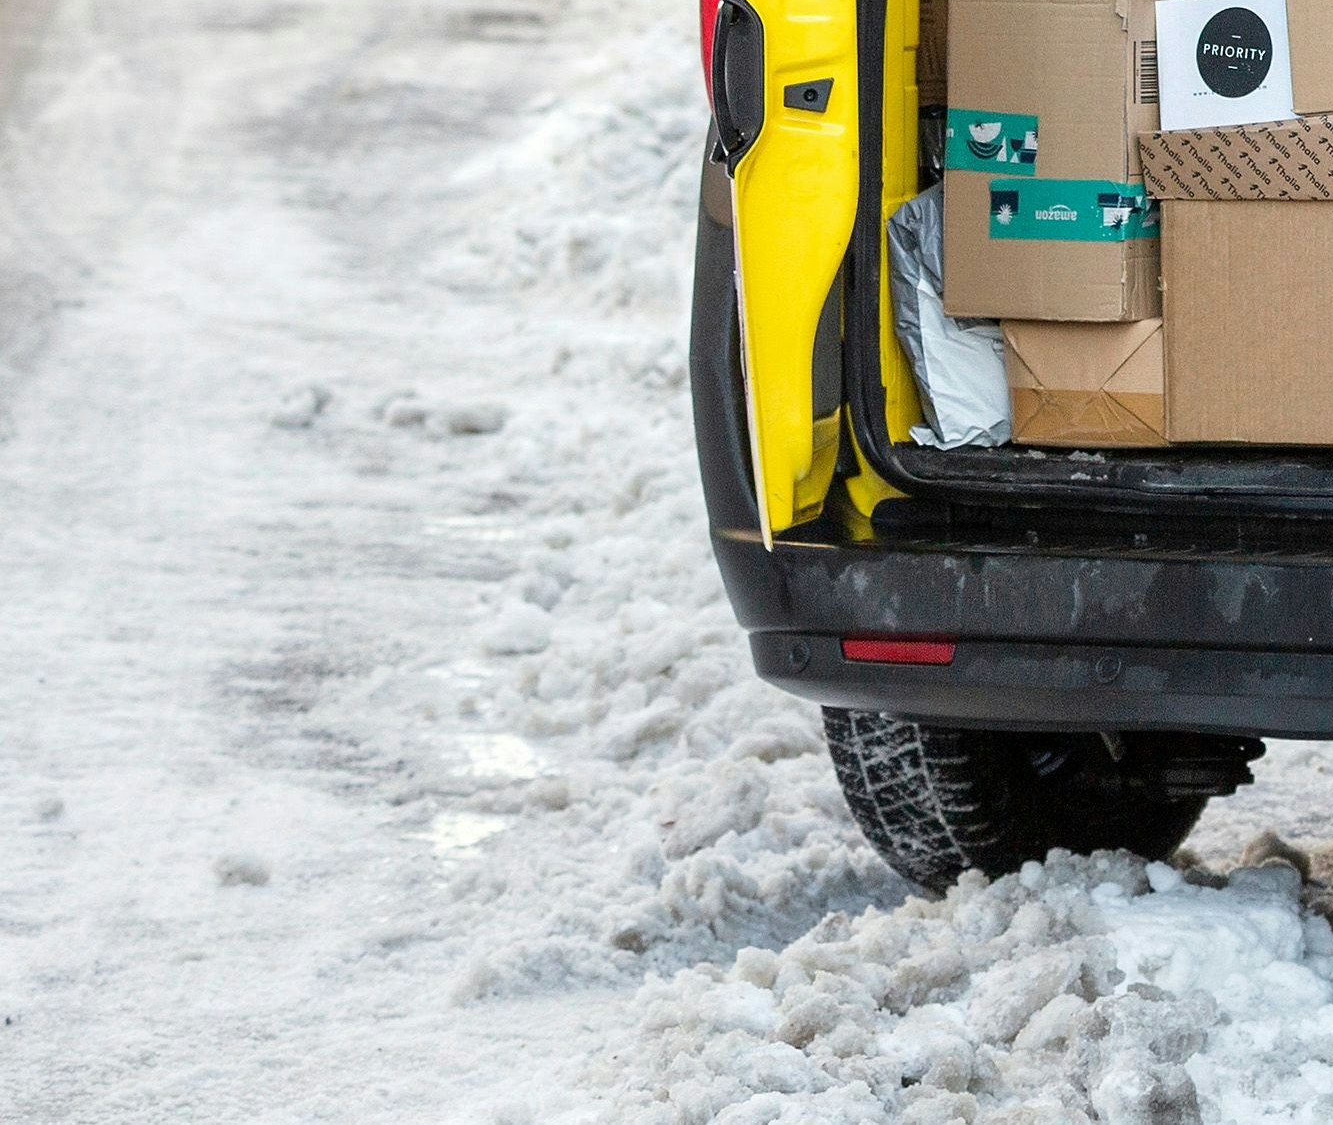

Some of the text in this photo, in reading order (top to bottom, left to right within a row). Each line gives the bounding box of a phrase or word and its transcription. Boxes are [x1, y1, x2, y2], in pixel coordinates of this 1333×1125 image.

[1203, 43, 1266, 61] PRIORITY
[1159, 139, 1185, 167] Thalia
[1188, 146, 1214, 174] Thalia
[1265, 132, 1291, 160] Thalia
[1296, 138, 1321, 165] Thalia
[1218, 152, 1243, 179] Thalia
[1246, 158, 1272, 186] Thalia
[1276, 164, 1301, 192] Thalia
[1170, 171, 1196, 199] Thalia
[1305, 170, 1331, 198] Thalia
[1035, 209, 1077, 221] amazon
